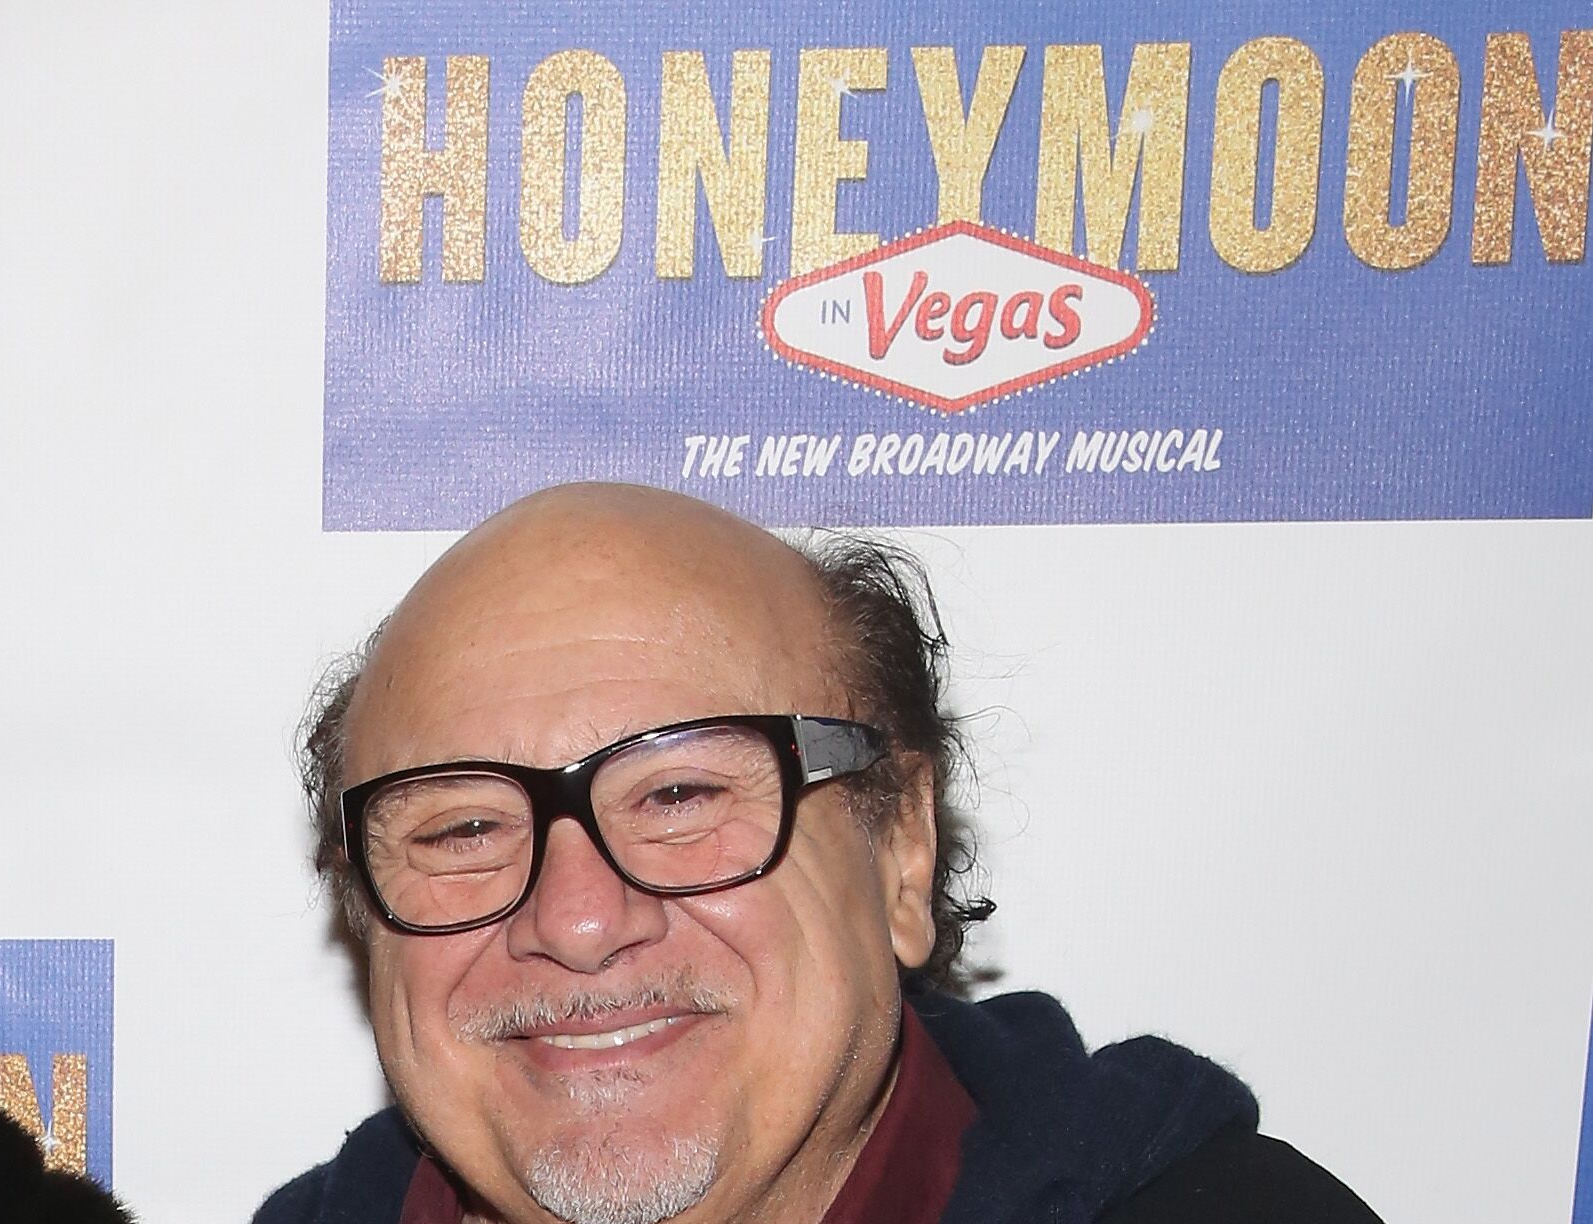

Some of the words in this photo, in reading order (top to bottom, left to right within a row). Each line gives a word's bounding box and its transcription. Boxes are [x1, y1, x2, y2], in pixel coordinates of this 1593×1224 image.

[380, 32, 1593, 284] HONEYMOON
[821, 299, 851, 324] IN
[863, 270, 1083, 366] Vegas
[682, 434, 750, 478] THE
[755, 434, 842, 477] NEW
[847, 431, 1060, 477] BROADWAY
[1065, 428, 1223, 474] MUSICAL
